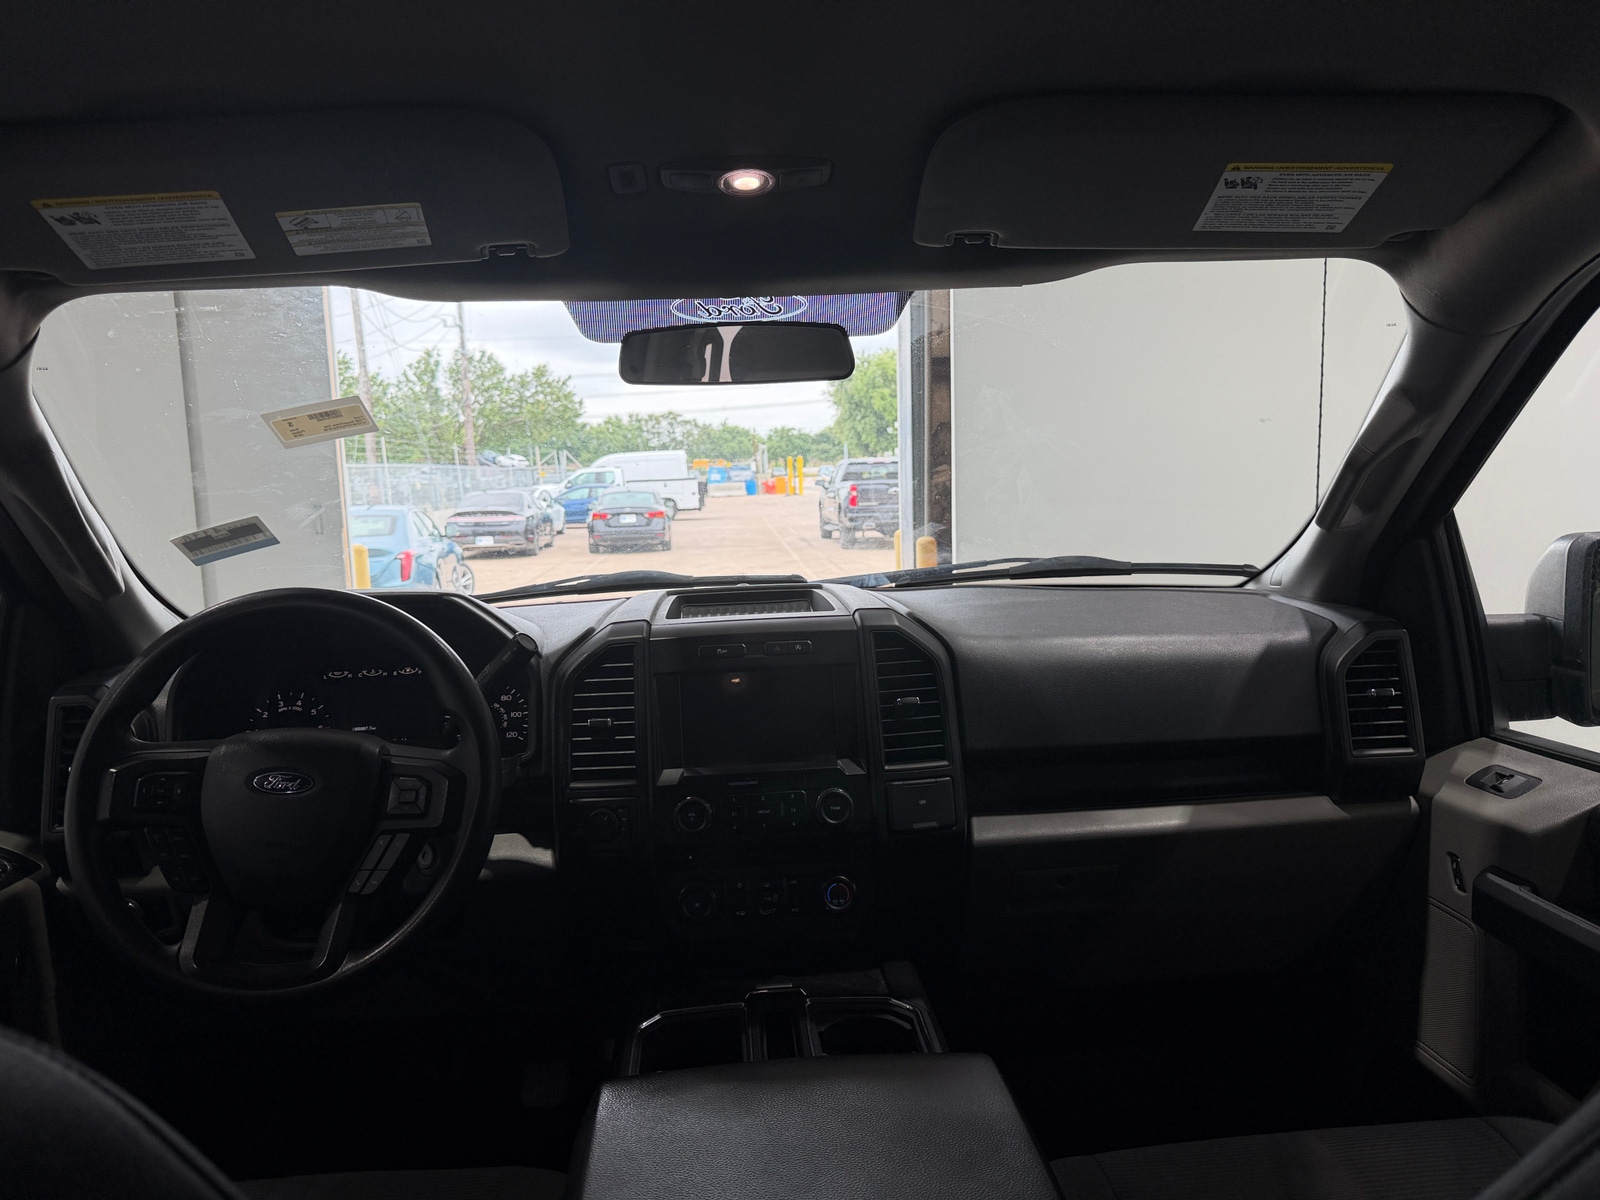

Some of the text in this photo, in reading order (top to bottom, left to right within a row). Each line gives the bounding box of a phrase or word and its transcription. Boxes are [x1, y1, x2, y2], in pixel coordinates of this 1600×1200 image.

[500, 694, 512, 702] 80
[310, 708, 317, 716] 5
[263, 774, 302, 791] Ford
